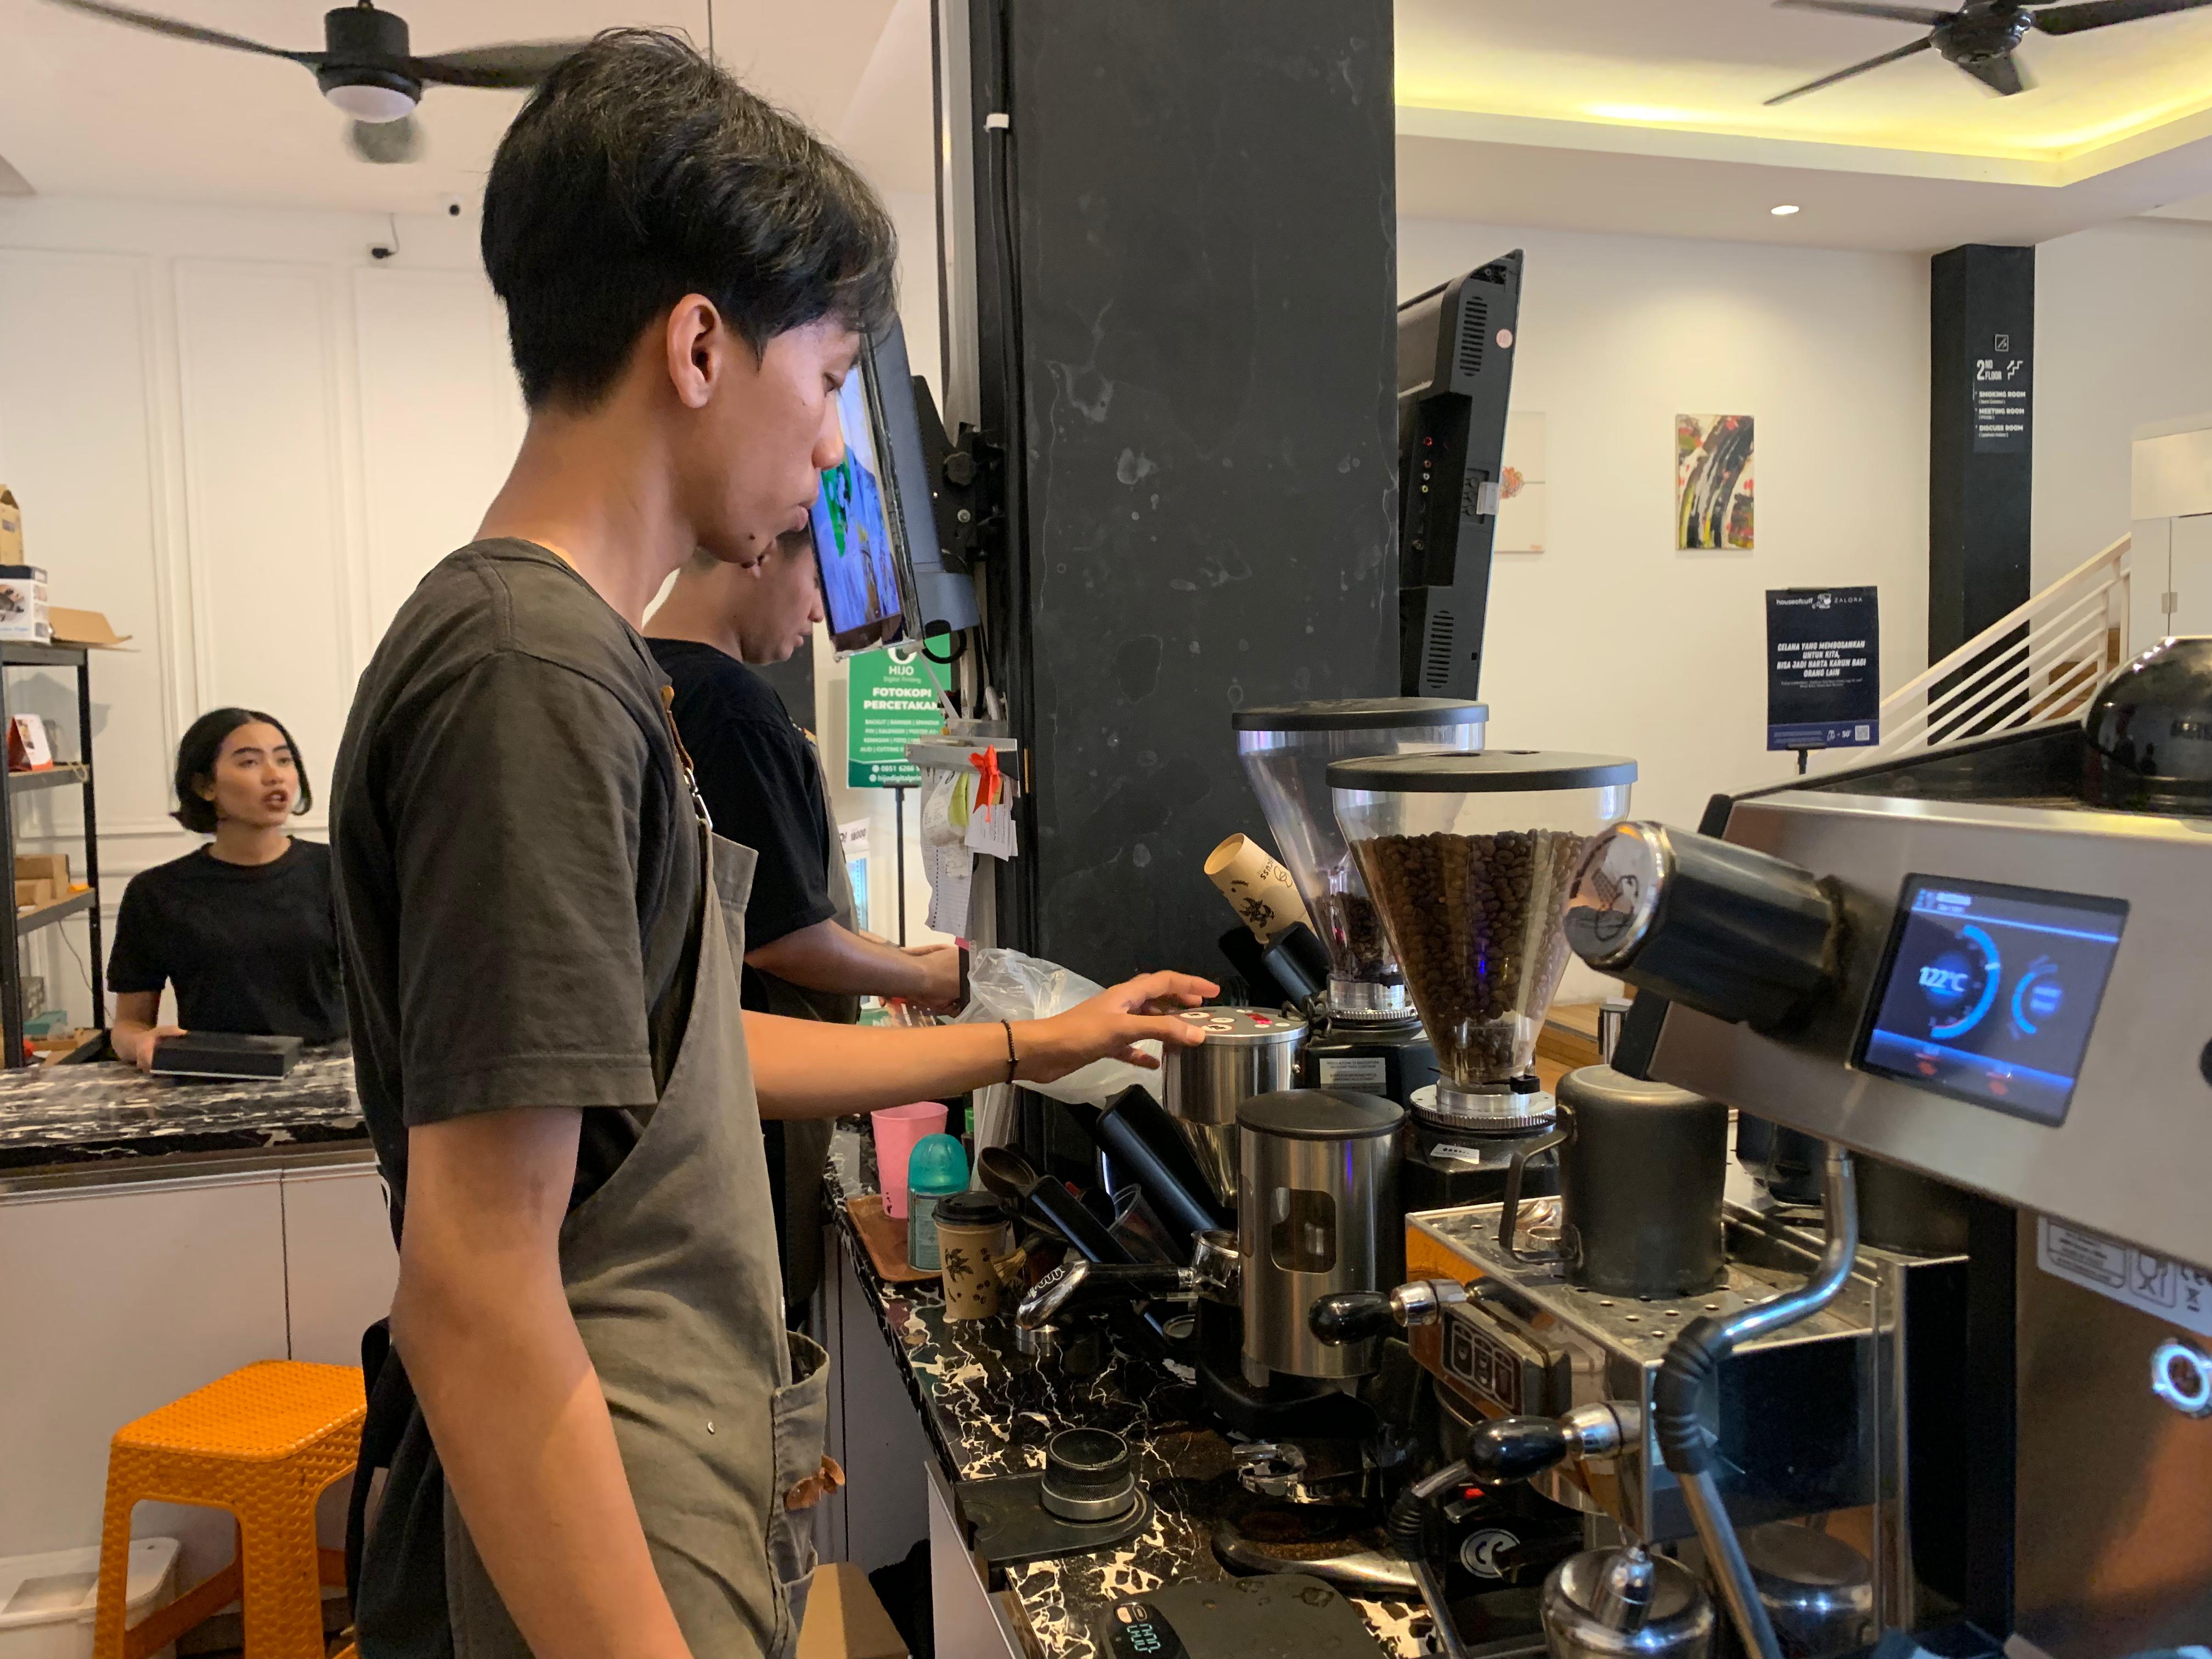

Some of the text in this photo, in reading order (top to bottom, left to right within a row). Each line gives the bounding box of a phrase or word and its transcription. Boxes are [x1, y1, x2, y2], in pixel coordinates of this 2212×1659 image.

[1985, 371, 2002, 381] FLOOR
[1778, 640, 1865, 652] CELANA YANG MEMBOSANKAN
[1803, 651, 1824, 659] UNTUK
[1776, 658, 1866, 670] BISA JADI HARTA KARUN BAGI
[889, 665, 915, 676] HIJO
[1803, 668, 1840, 678] ORANG LAIN
[873, 687, 932, 698] FOTOKOPI
[864, 699, 940, 710] PERCETAKAN
[877, 774, 922, 782] hijodigitalprin
